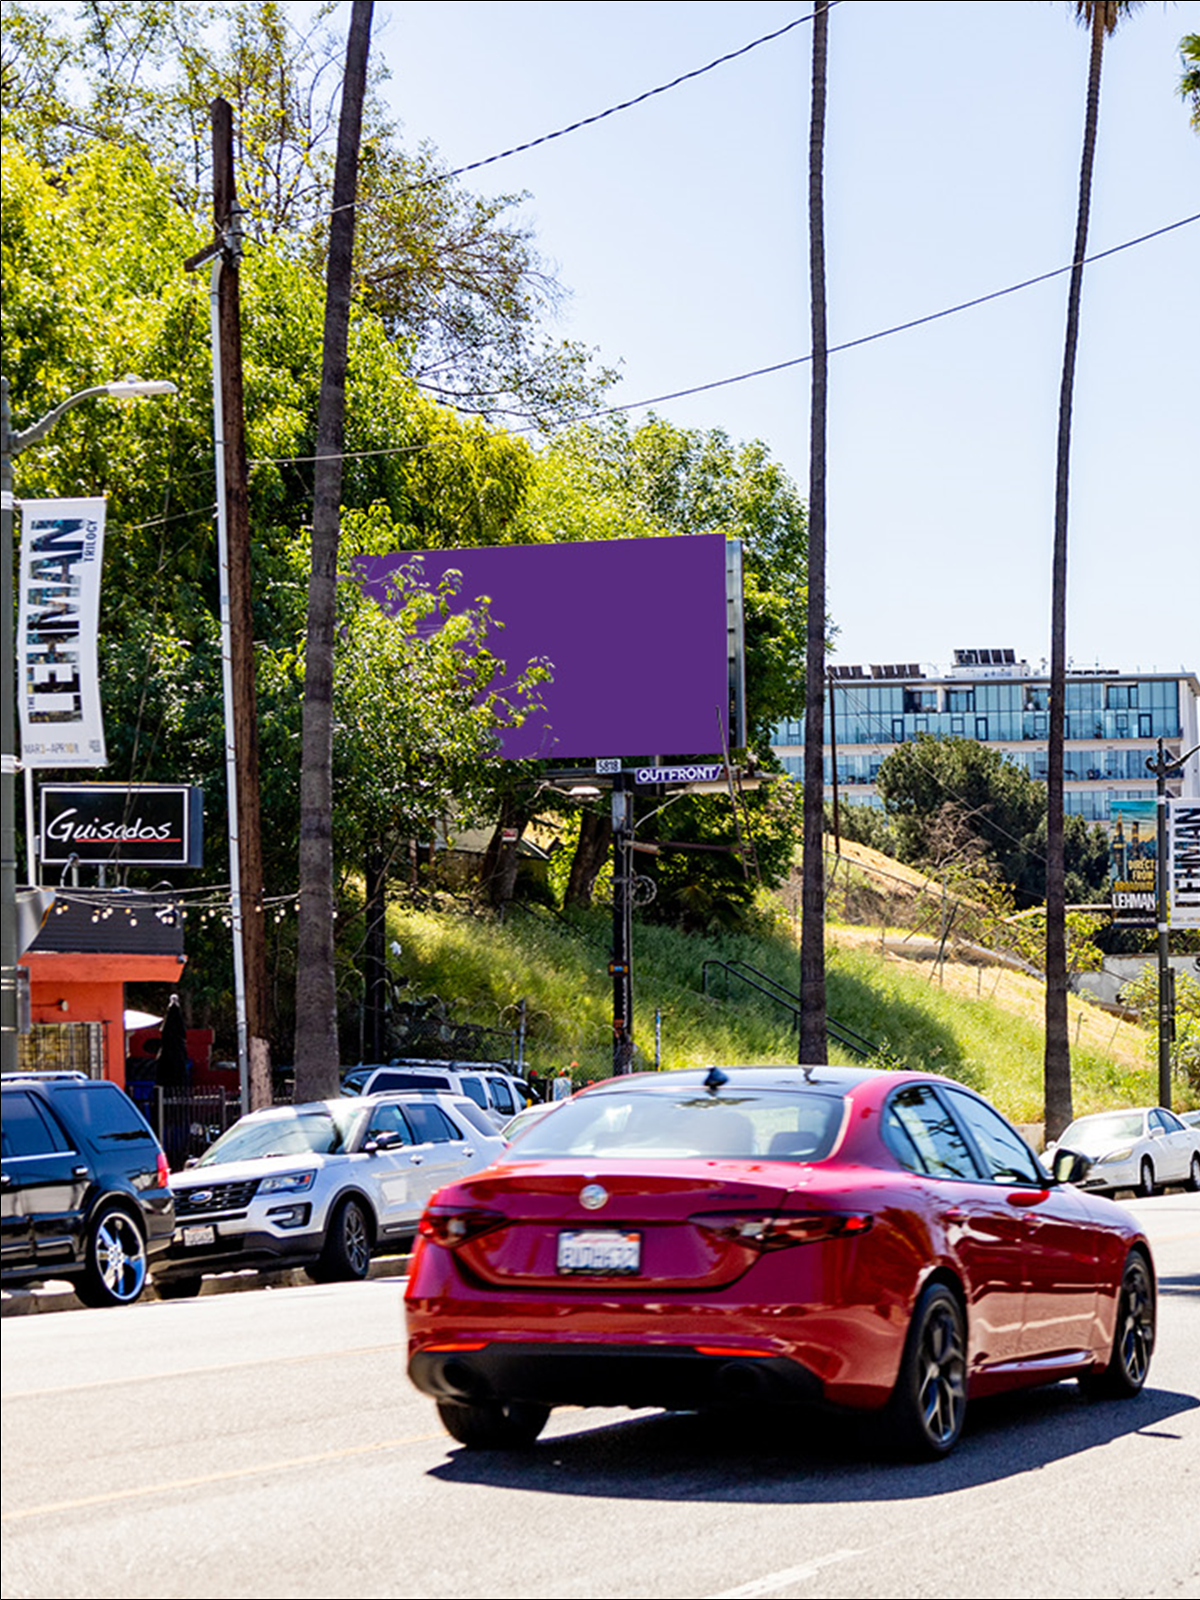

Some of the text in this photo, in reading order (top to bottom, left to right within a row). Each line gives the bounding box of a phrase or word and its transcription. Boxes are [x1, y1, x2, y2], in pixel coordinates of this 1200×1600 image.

[84, 520, 97, 562] TRILOGY
[27, 519, 84, 723] LEHMAN
[638, 766, 717, 781] OUTFRONT
[47, 808, 172, 842] Guisados
[1112, 893, 1156, 911] LEHMAN
